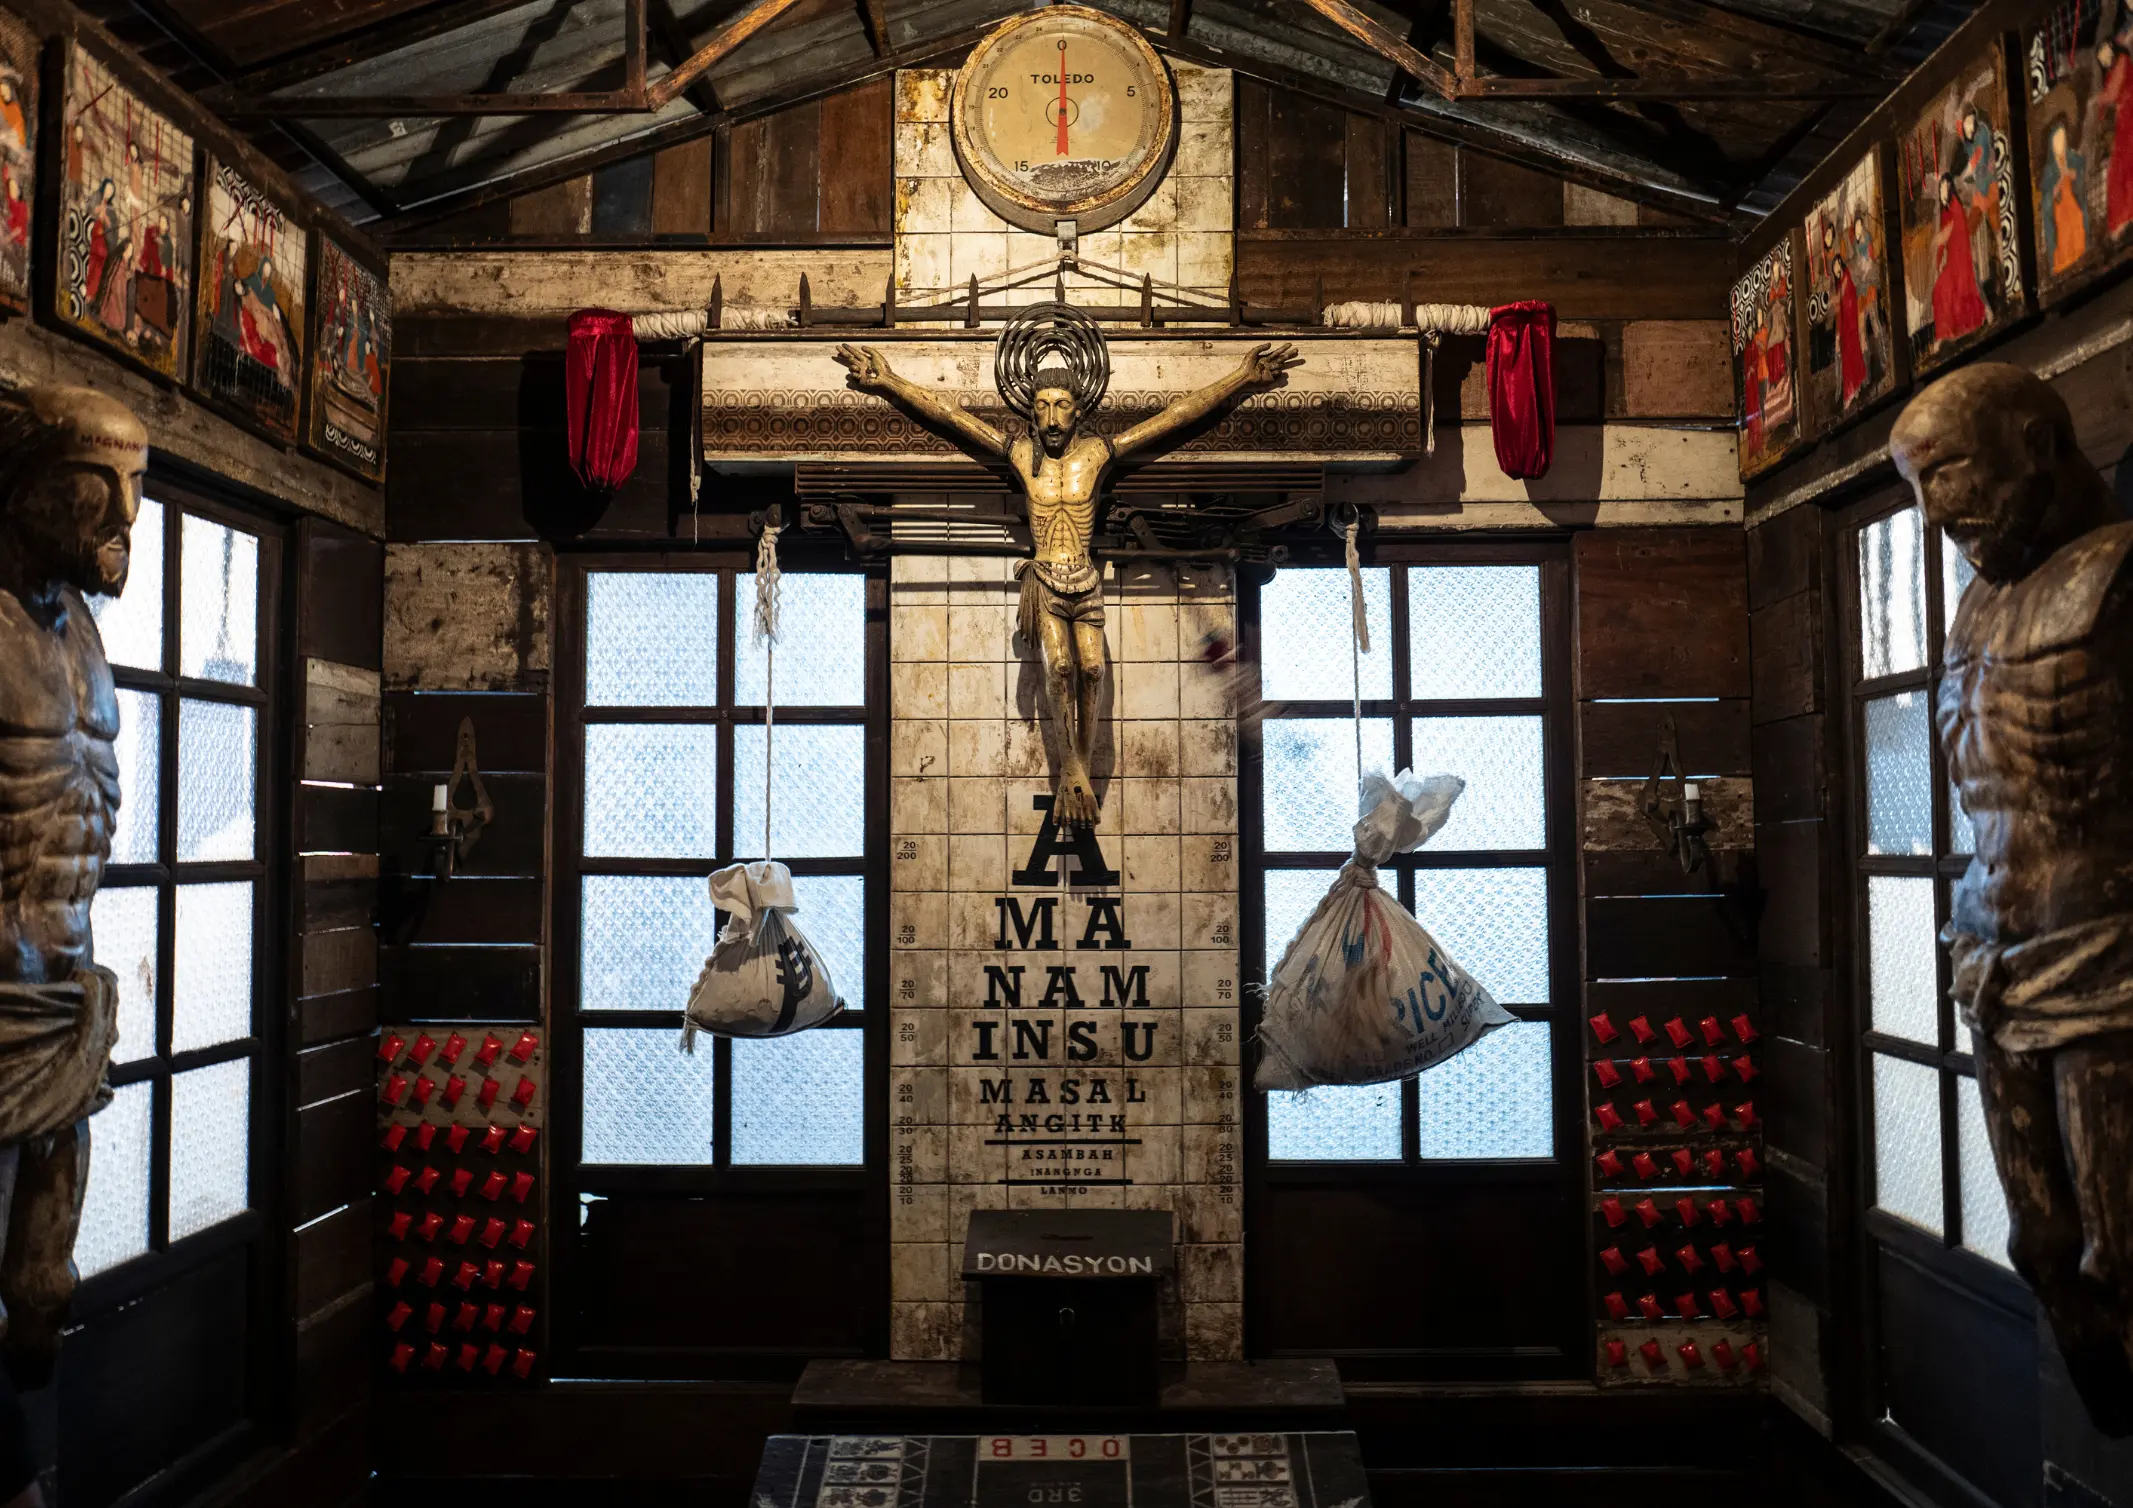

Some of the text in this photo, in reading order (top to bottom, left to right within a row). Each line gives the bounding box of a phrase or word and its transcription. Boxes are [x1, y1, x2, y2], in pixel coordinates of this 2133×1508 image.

[1057, 40, 1067, 50] 0
[1030, 74, 1094, 84] TOLEDO
[988, 87, 1008, 99] 20
[1127, 86, 1135, 97] 5
[1014, 161, 1029, 172] 15
[1097, 160, 1111, 171] 10
[1012, 794, 1120, 886] A
[903, 841, 916, 849] 20
[1214, 841, 1227, 849] 20
[897, 852, 917, 860] 200
[1210, 854, 1229, 862] 200
[902, 925, 915, 934] 20
[1216, 925, 1229, 933] 20
[897, 936, 915, 944] 100
[1211, 936, 1229, 944] 100
[901, 980, 914, 989] 20
[983, 966, 1150, 1008] NAM
[1218, 979, 1232, 988] 20
[901, 991, 915, 999] 70
[1218, 991, 1232, 999] 70
[901, 1023, 914, 1031] 20
[1218, 1023, 1232, 1032] 20
[900, 1034, 914, 1042] 50
[972, 1020, 1158, 1060] INSU
[1218, 1034, 1232, 1042] 50
[1406, 1032, 1439, 1054] WELL
[899, 1084, 912, 1092] 20
[1220, 1080, 1232, 1088] 20
[980, 1078, 1146, 1104] MASAL
[1220, 1091, 1233, 1099] 40
[899, 1116, 912, 1124] 20
[1220, 1114, 1232, 1122] 20
[994, 1114, 1127, 1133] ANGITK
[1021, 1149, 1113, 1160] ASAMBAH
[1220, 1154, 1232, 1162] 25
[899, 1156, 912, 1164] 25
[899, 1186, 912, 1194] 20
[1220, 1185, 1232, 1193] 20
[900, 1197, 912, 1205] 10
[977, 1252, 1153, 1274] DONASYON
[1028, 1487, 1082, 1503] 3RD
